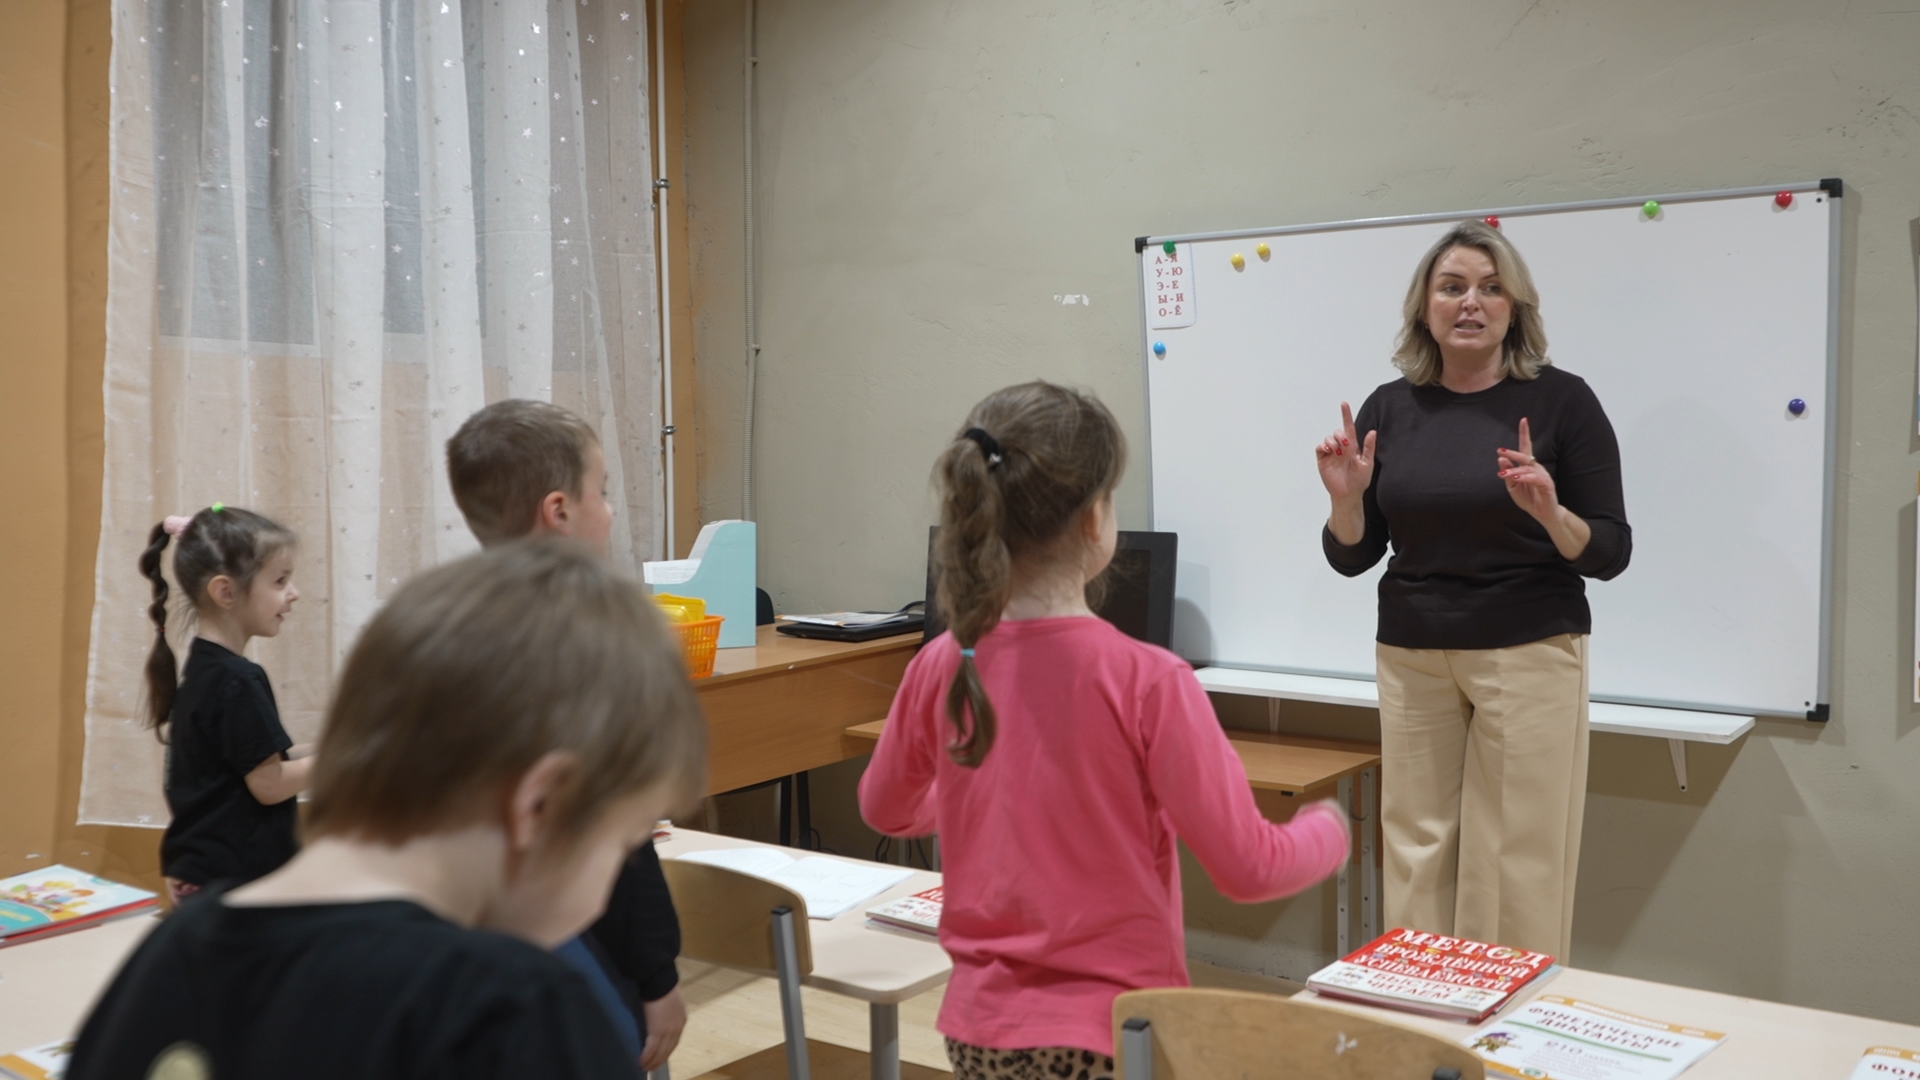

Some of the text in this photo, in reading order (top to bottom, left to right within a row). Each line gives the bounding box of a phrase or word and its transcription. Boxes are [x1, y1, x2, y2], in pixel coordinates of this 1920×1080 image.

[1155, 256, 1162, 264] А
[1170, 254, 1178, 263] Я
[1156, 268, 1163, 277] У
[1171, 267, 1183, 276] Ю
[1157, 282, 1164, 291] Э
[1172, 280, 1179, 289] Е
[1158, 295, 1168, 304] Ы
[1158, 308, 1167, 317] О
[1175, 305, 1182, 316] Ё
[1392, 929, 1549, 969] МЕТОД
[1354, 954, 1514, 991] УСПЕВАЕМОСТИ
[1367, 979, 1451, 1000] ЧИТАЕМ
[1373, 973, 1463, 994] БЫСТРО
[1528, 1006, 1684, 1048] ФОНЕТИЧЕСКИЕ
[1536, 1017, 1650, 1050] ДИКТАНТЫ
